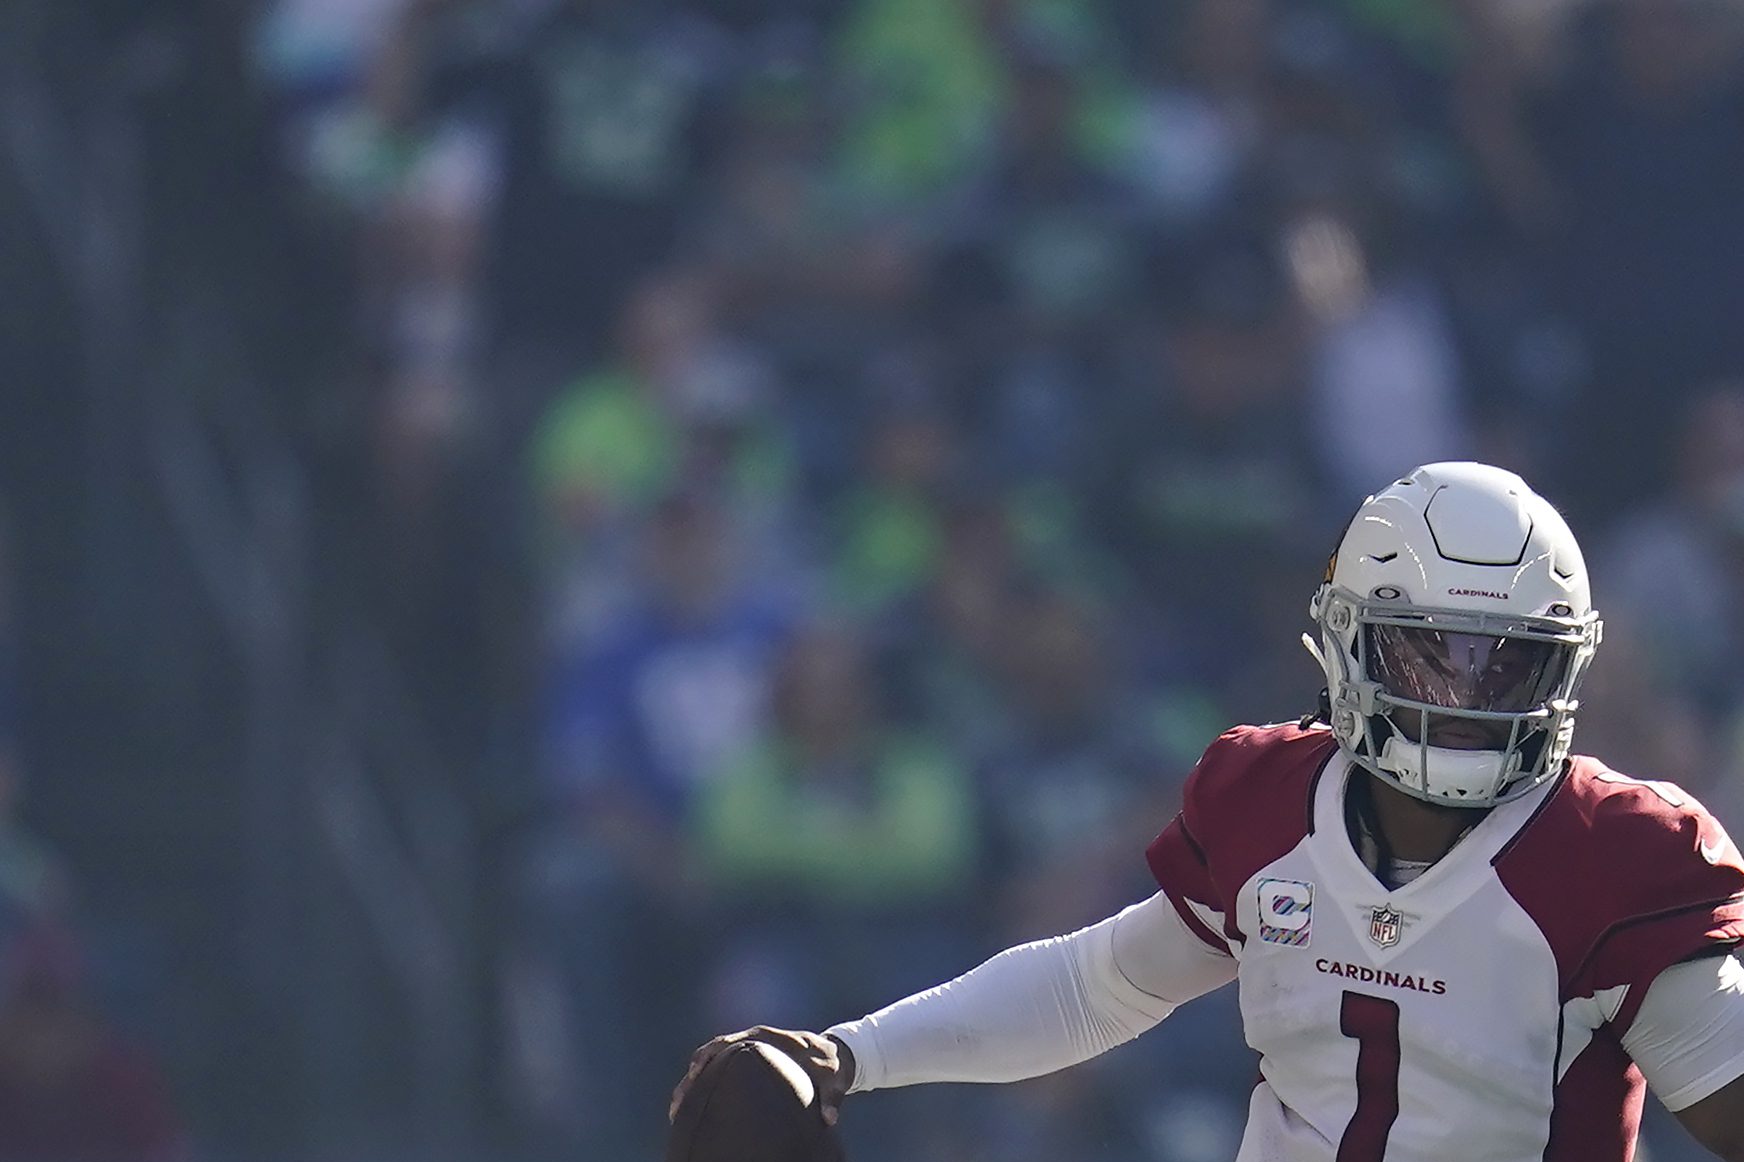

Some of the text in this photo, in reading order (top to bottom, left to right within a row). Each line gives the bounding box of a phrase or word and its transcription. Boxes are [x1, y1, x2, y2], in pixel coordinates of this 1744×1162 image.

[1448, 588, 1509, 600] CARDINALS
[1258, 881, 1311, 930] C
[1372, 922, 1395, 941] NFL
[1315, 958, 1447, 995] CARDINALS
